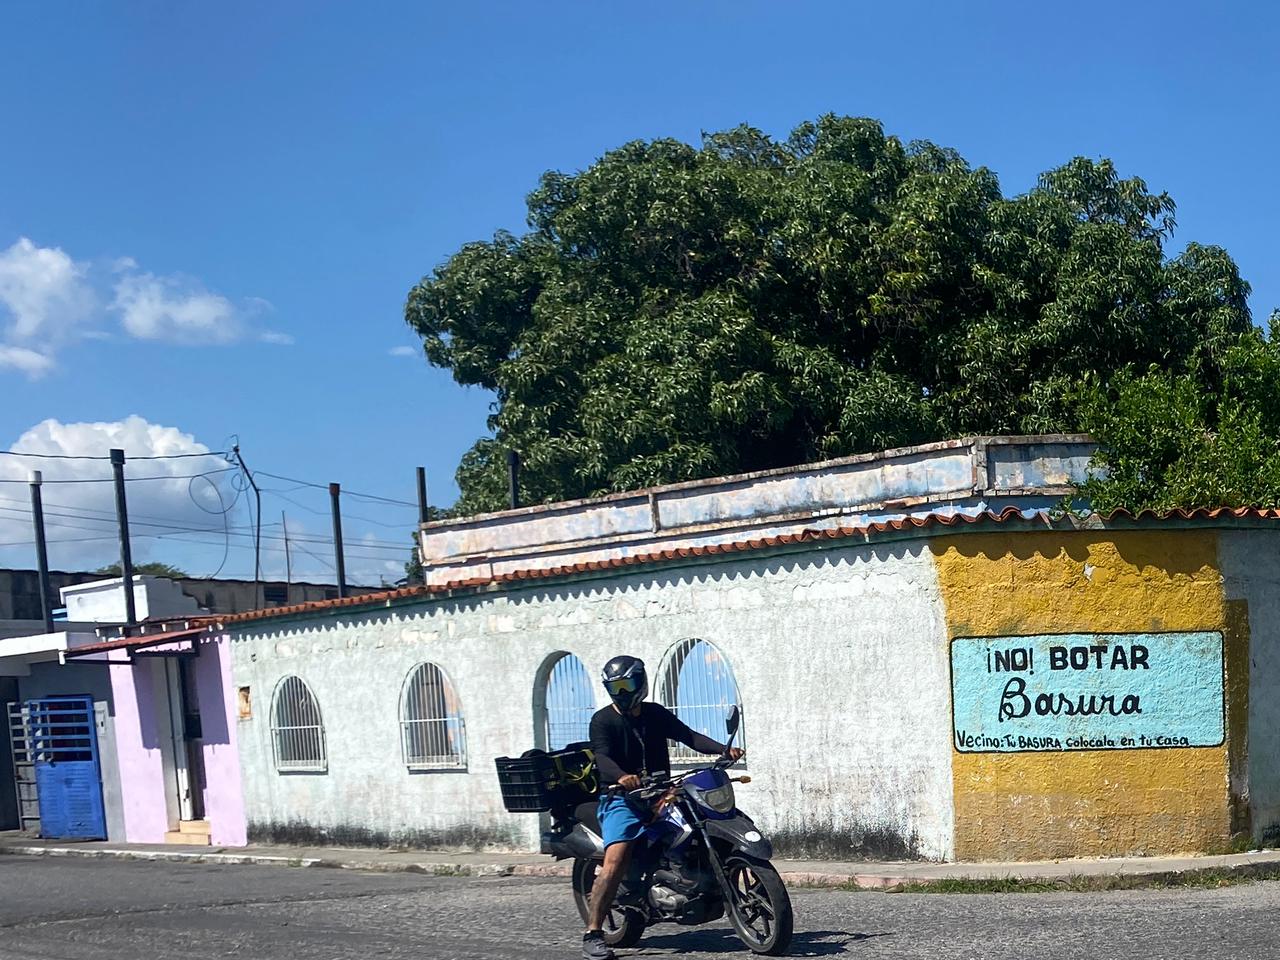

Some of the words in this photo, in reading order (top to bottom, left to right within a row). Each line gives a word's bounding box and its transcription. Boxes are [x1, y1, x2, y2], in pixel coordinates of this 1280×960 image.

[986, 647, 1035, 675] ¡NO!
[1049, 645, 1150, 671] BOTAR
[998, 676, 1143, 723] Basura
[1017, 735, 1062, 748] BASURA
[1120, 737, 1135, 747] en
[1139, 734, 1153, 746] tu
